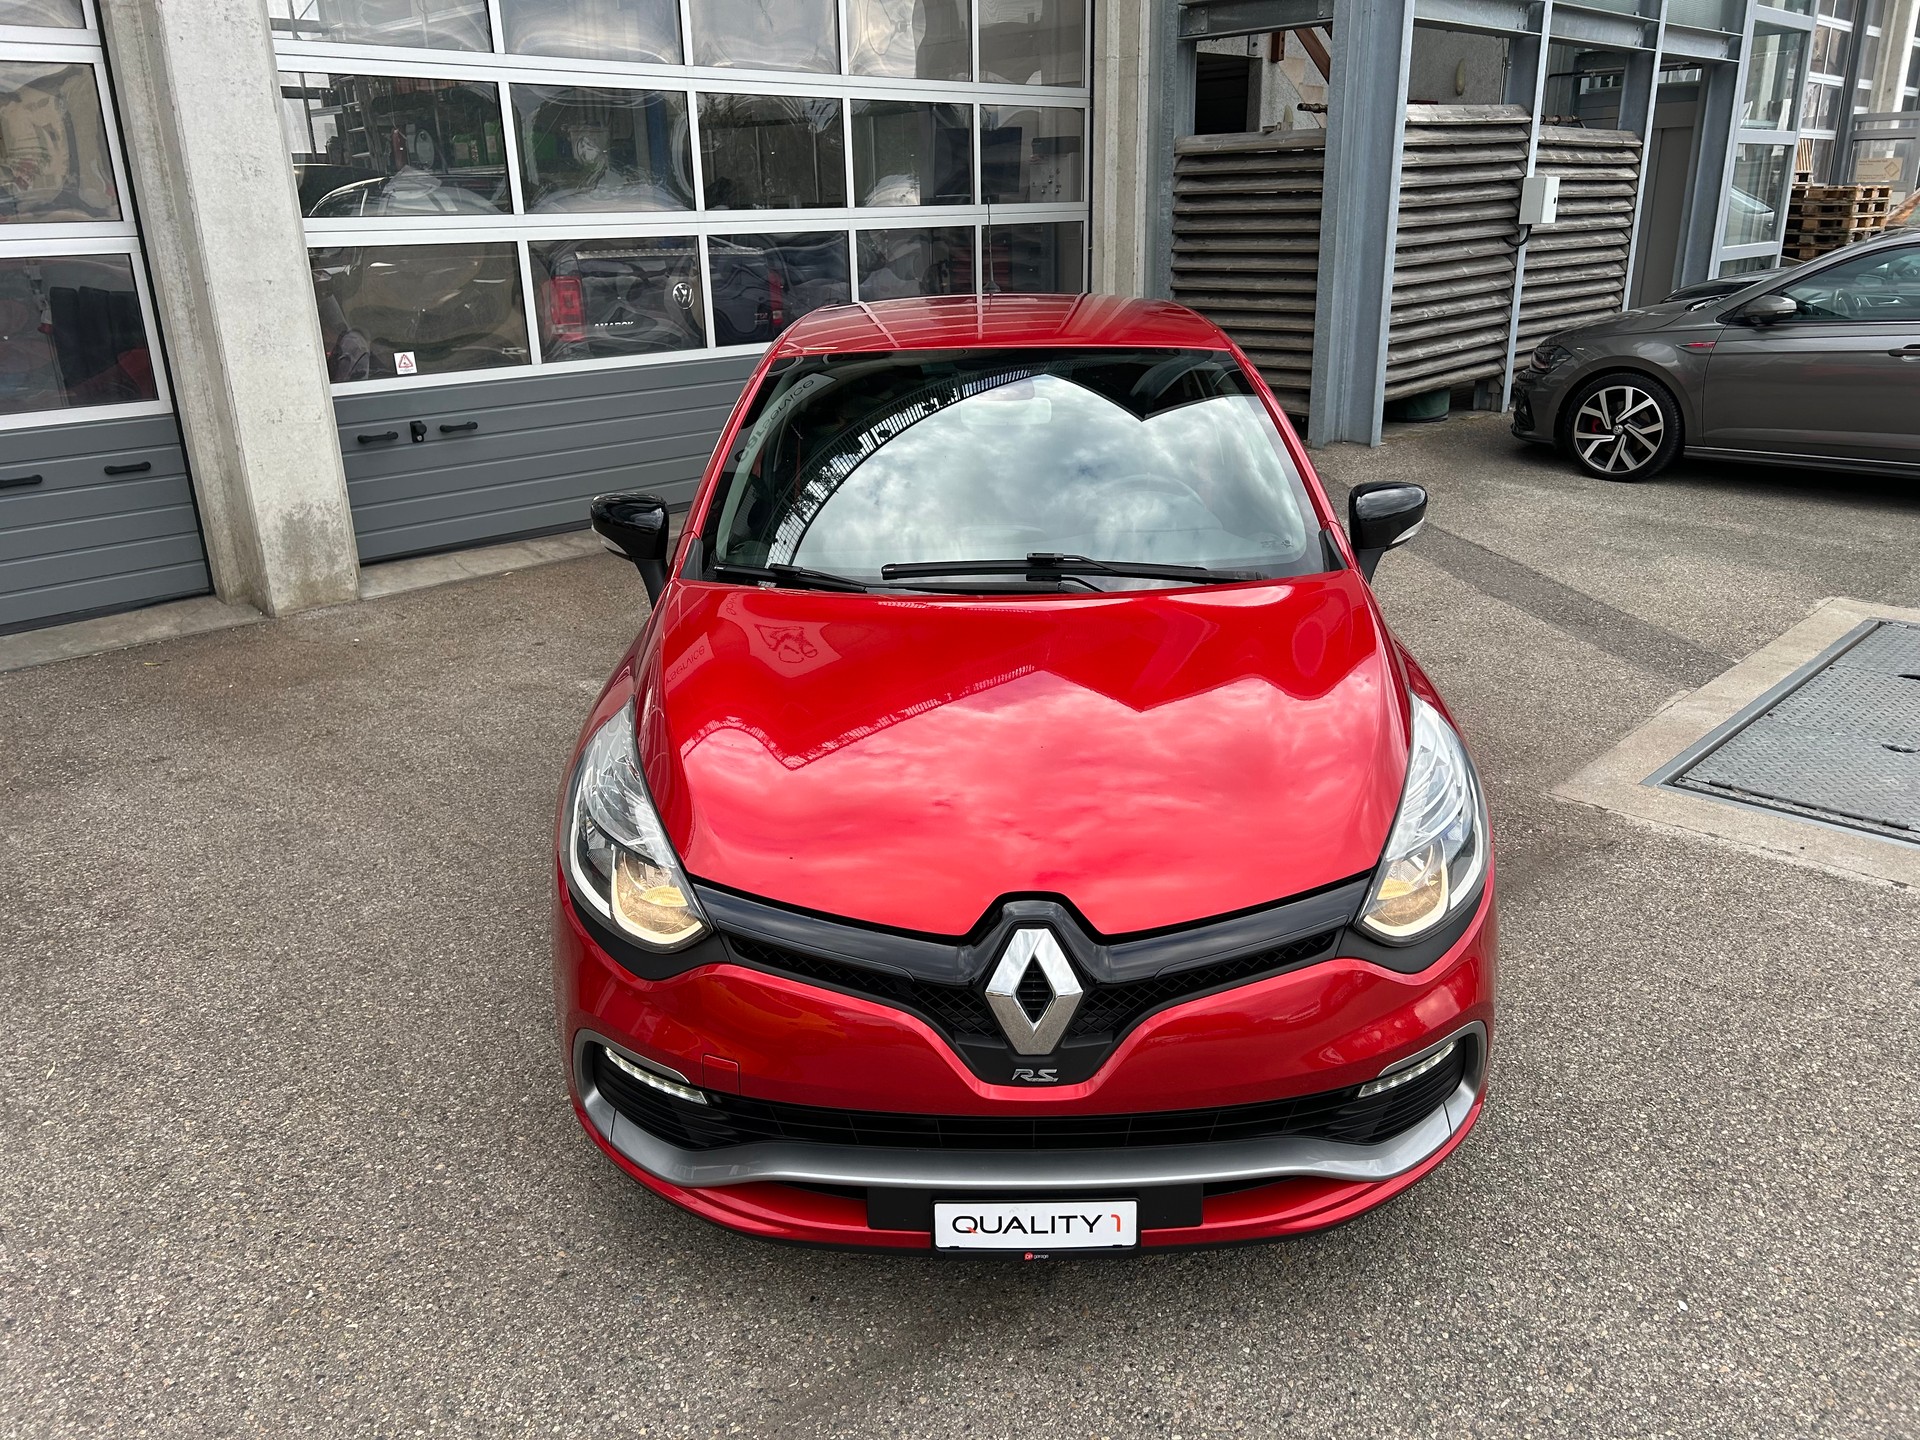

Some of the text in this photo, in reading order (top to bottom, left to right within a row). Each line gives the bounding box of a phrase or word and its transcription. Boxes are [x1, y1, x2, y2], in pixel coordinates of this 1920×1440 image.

[1012, 1068, 1059, 1083] RS
[952, 1214, 1121, 1234] QUALITY 1
